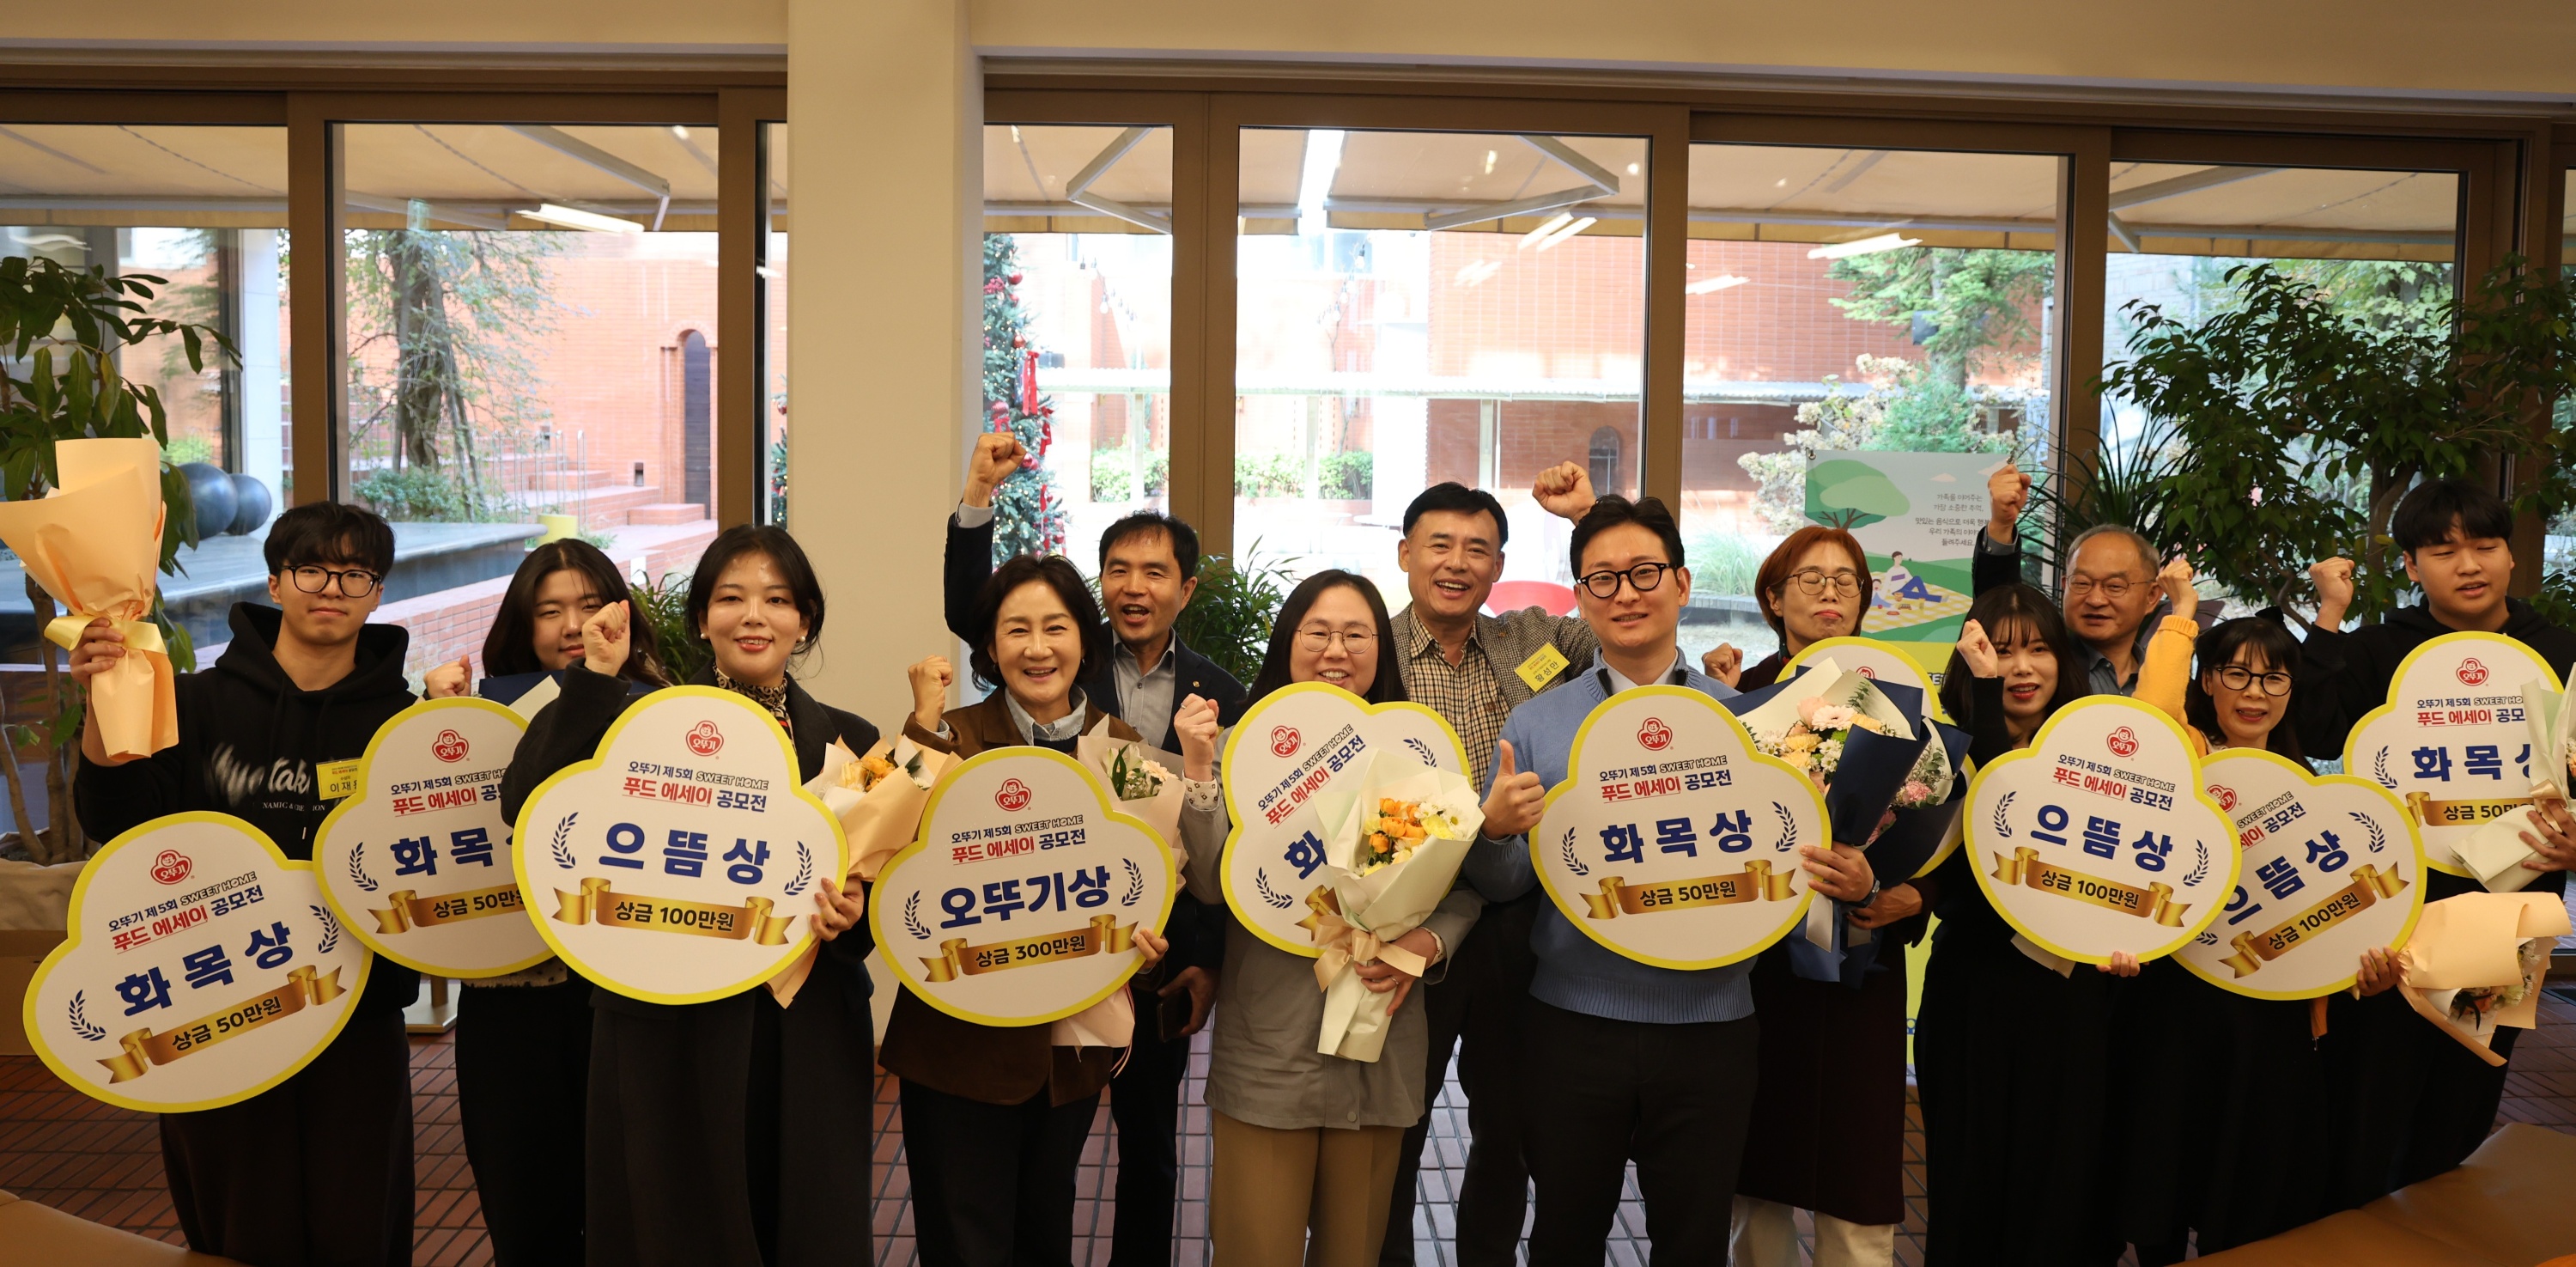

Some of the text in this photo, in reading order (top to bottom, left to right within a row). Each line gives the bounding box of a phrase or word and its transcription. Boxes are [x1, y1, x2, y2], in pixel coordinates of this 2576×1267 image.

[1915, 517, 1935, 526] 맛있는
[1936, 517, 1961, 526] 음식으로
[2416, 696, 2523, 709] 오뚜기 제5회 SWEET HO
[2418, 708, 2526, 725] 푸드 에세이 공모
[440, 746, 464, 758] 오뚜기
[693, 737, 716, 751] 오뚜기
[1279, 736, 1298, 754] 오뚜기
[1645, 734, 1667, 744] 오뚜기
[2112, 740, 2132, 754] 오뚜기
[628, 761, 769, 790] 오뚜기 제5회 SWEET HOME
[1257, 723, 1353, 811] 오뚜기 제5회 SWEET HOME
[1266, 734, 1366, 825] 푸드 에세이 공모전
[1599, 756, 1728, 782] 오뚜기 제5회 SWEET HOME
[2057, 754, 2176, 793] 오뚜기 제5회 SWEET HOME
[392, 782, 421, 795] 오뚜기
[423, 777, 452, 790] 제5회
[455, 772, 491, 785] SWEET
[623, 777, 767, 813] 푸드 에세이 공모전
[1601, 770, 1732, 801] 푸드 에세이 공모전
[2052, 766, 2173, 812] 푸드 에세이 공모전
[393, 796, 426, 814] 푸드
[428, 787, 477, 809] 에세이
[1003, 794, 1025, 806] 오뚜기
[2237, 790, 2294, 830] SWEET HOME
[2443, 806, 2475, 821] 상금
[951, 814, 1084, 844] 오뚜기 제5회 SWEET HOME
[2239, 801, 2306, 848] 세이 공모전
[952, 828, 1085, 862] 푸드 에세이 공모전
[160, 863, 186, 880] 오뚜기
[108, 871, 258, 932] 오뚜기 제5회 SWEET HOME
[940, 866, 1110, 929] 오뚜기상
[1640, 880, 1736, 907] 상금 50만원
[2040, 869, 2140, 910] 상금 100만원
[112, 885, 264, 951] 푸드 에세이 공모전
[433, 898, 468, 918] 상금
[615, 901, 735, 932] 상금 100만원
[2269, 892, 2361, 951] 상금 100만원
[975, 935, 1085, 968] 상금 300만원
[172, 996, 282, 1051] 상금 50만원
